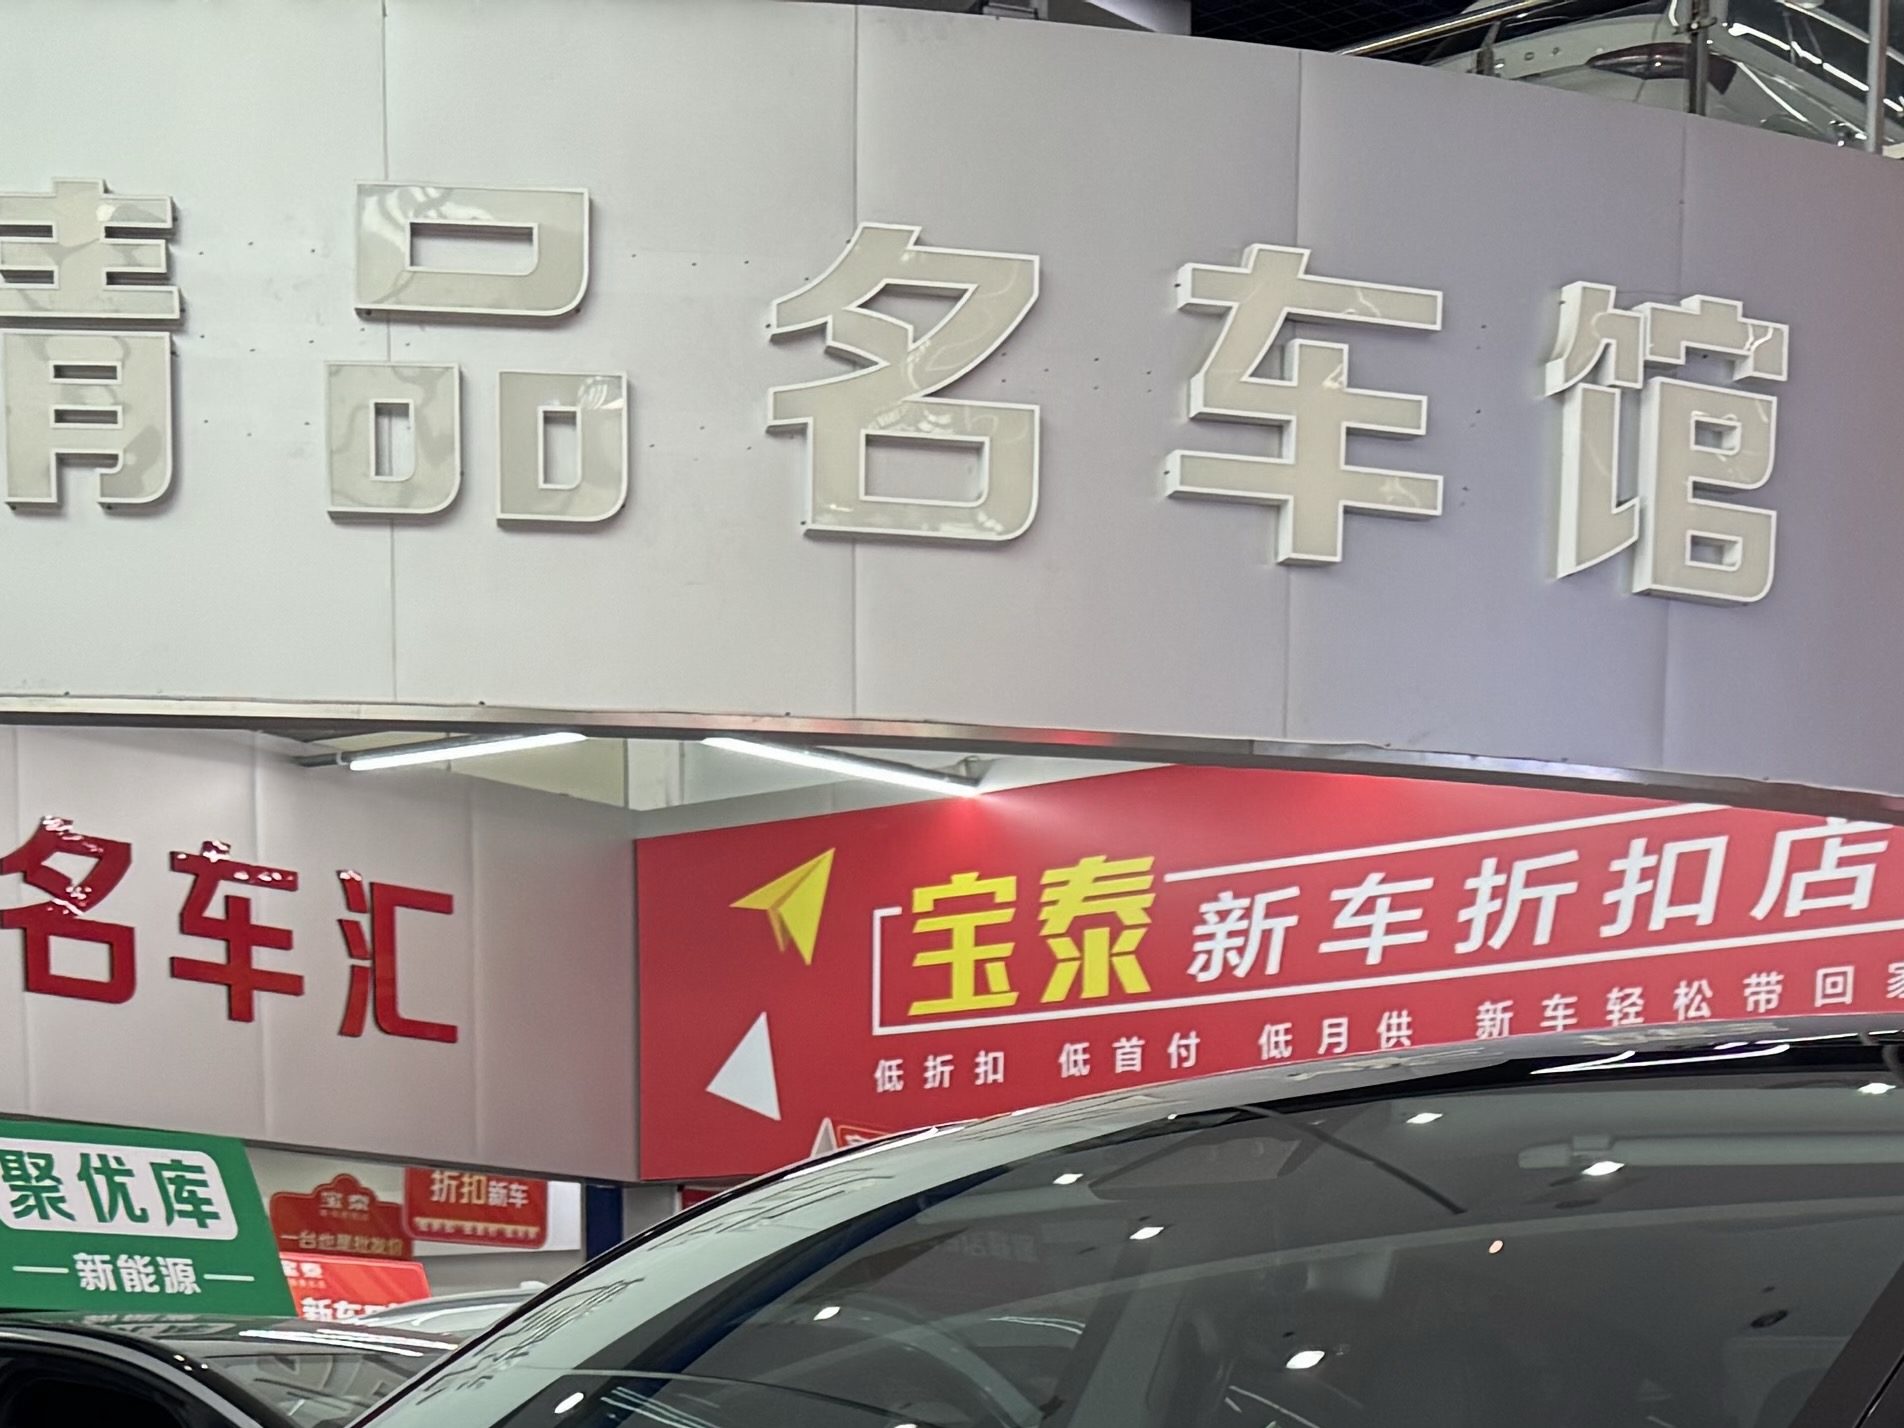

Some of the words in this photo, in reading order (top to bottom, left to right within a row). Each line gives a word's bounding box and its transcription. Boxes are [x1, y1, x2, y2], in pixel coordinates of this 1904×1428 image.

[908, 855, 1155, 1016] 宝泰
[1187, 815, 1893, 983] 新车折扣店
[873, 1051, 1006, 1094] 低折扣
[1059, 1031, 1202, 1076] 低首付
[1258, 1009, 1414, 1055] 低月供
[430, 1169, 530, 1209] 折扣新车
[73, 1252, 202, 1297] 新能源
